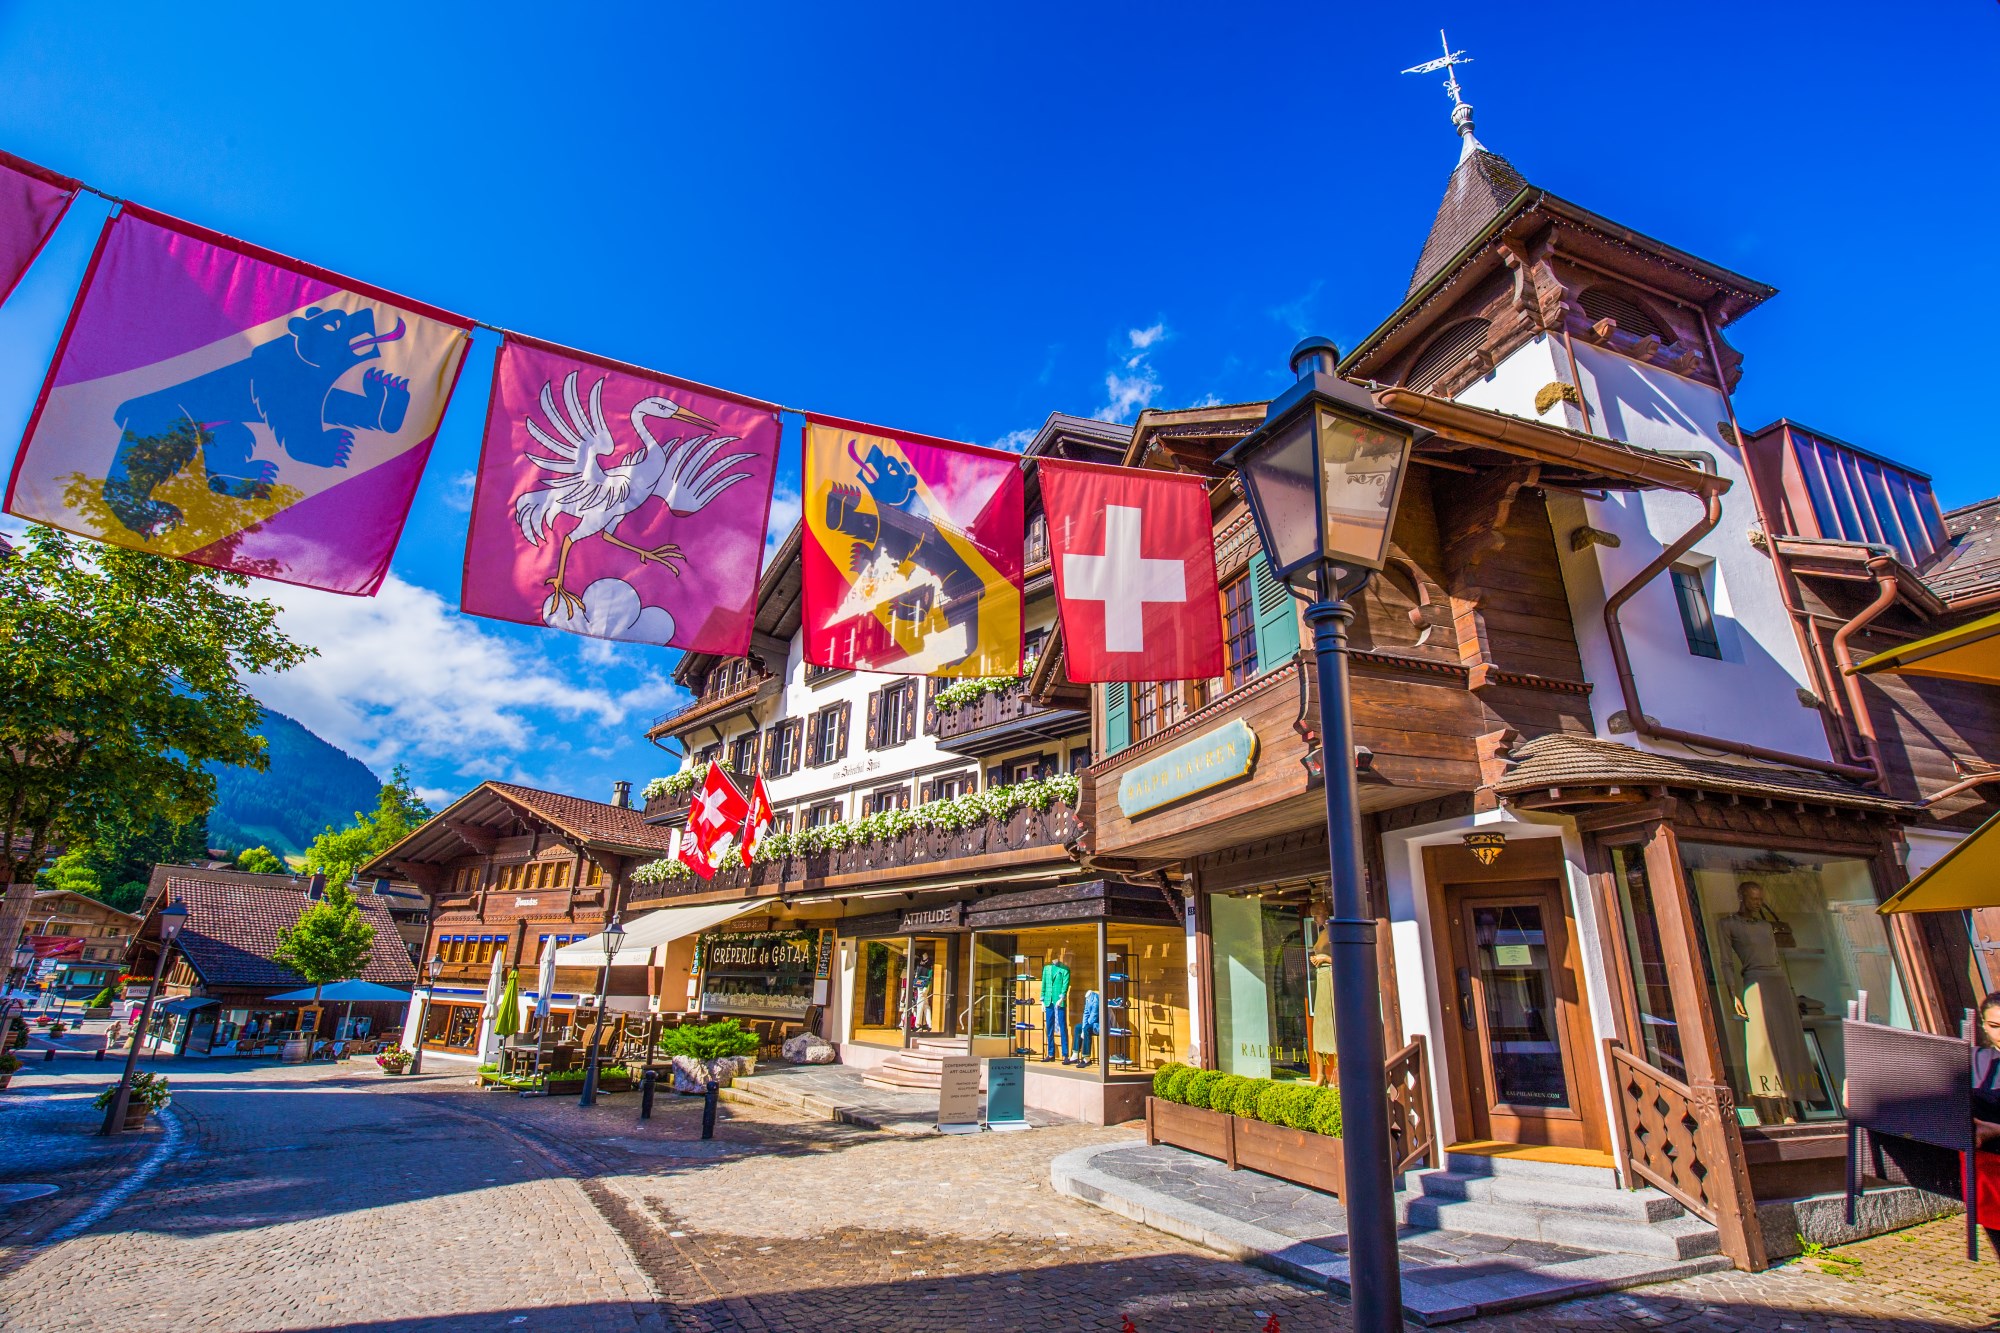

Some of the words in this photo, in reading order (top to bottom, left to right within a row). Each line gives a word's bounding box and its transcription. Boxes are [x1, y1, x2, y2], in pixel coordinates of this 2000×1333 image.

[1127, 770, 1169, 800] RALPH
[1175, 740, 1237, 781] LAUREN
[903, 909, 951, 925] ATTITUDE
[713, 943, 757, 965] CRÊPERIE
[759, 947, 769, 965] de
[771, 944, 810, 966] GSTAA
[1241, 1043, 1284, 1061] RALPH
[1292, 1047, 1339, 1068] LAUR
